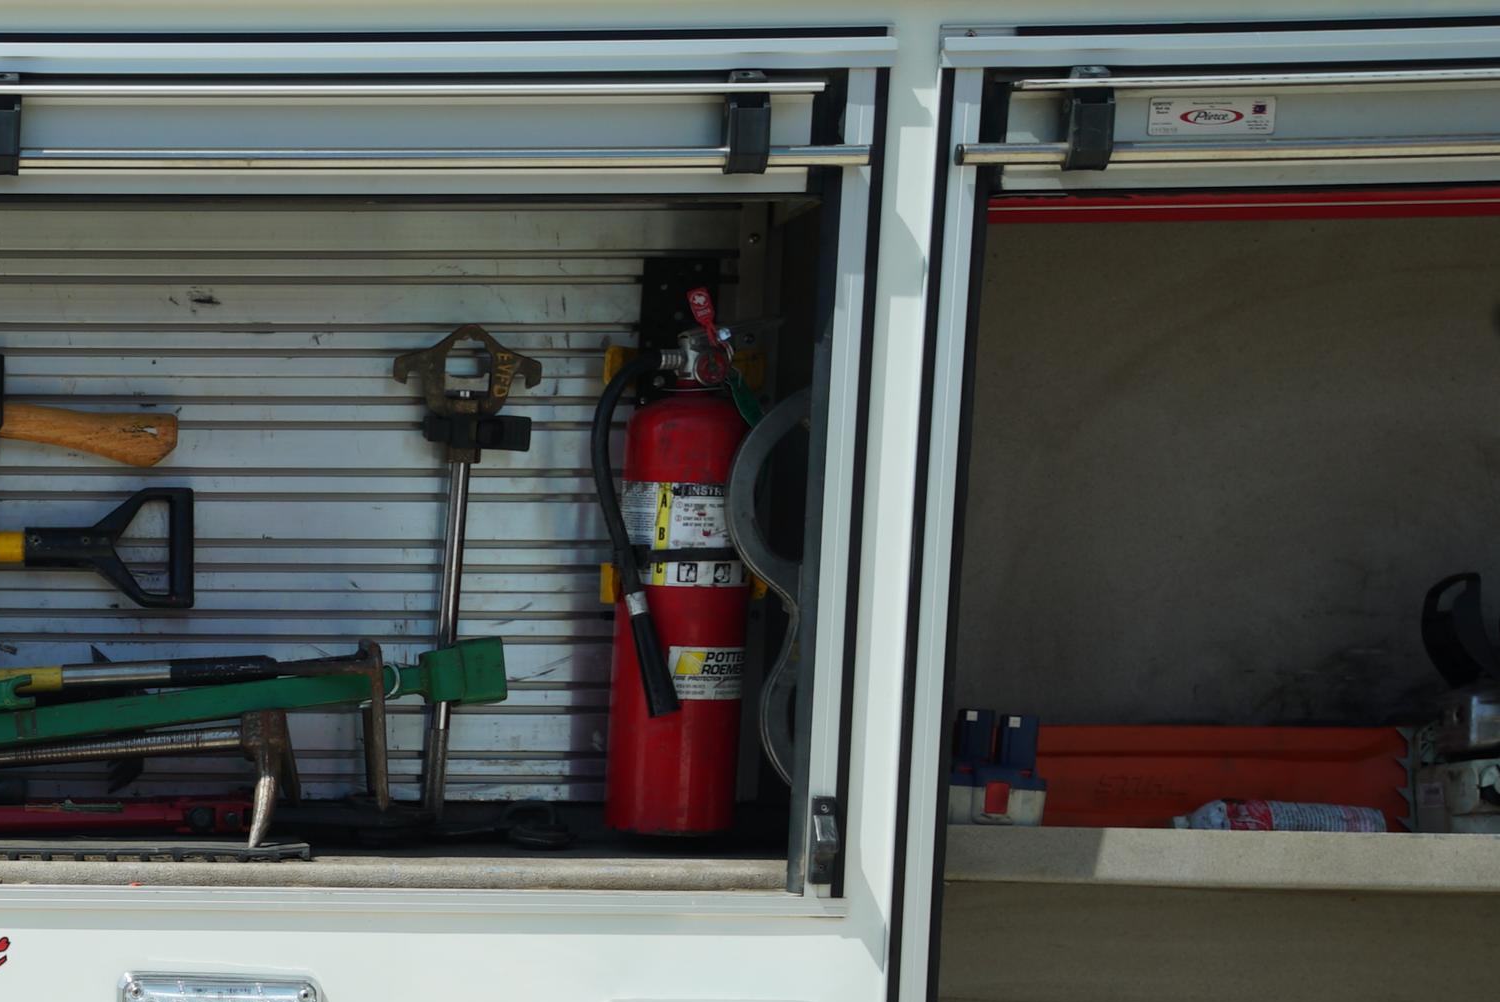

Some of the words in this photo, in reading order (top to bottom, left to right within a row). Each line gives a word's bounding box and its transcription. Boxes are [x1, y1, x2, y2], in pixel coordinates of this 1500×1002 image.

[1194, 111, 1228, 122] Pierce
[689, 485, 725, 496] INSTR
[660, 493, 668, 508] A
[658, 527, 666, 541] B
[705, 651, 744, 663] POTTE
[701, 664, 742, 674] ROEME
